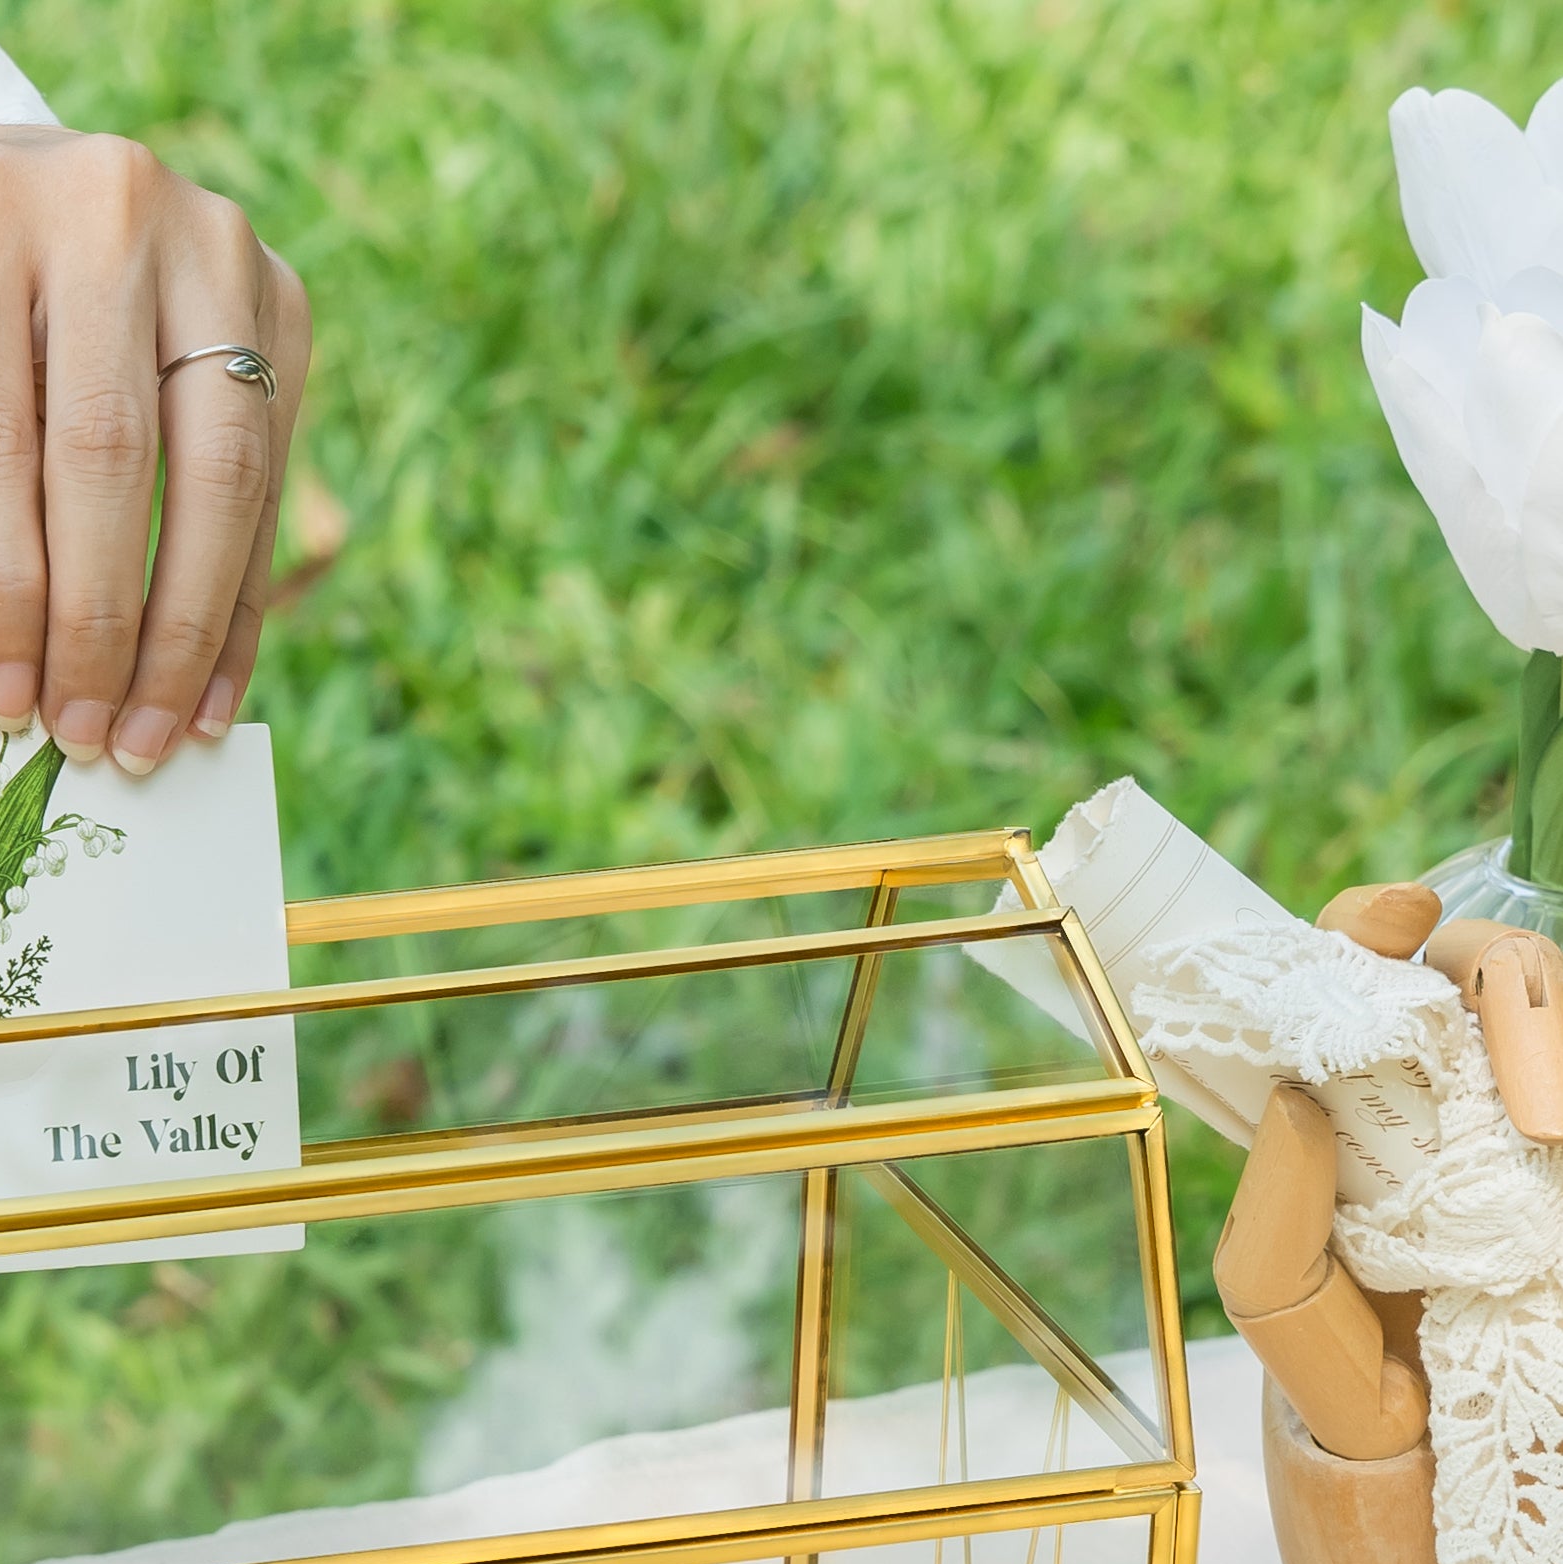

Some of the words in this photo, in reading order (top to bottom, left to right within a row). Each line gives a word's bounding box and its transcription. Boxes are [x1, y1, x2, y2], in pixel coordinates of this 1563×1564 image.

[126, 1052, 198, 1101] Lily
[216, 1045, 265, 1084] Of
[43, 1124, 122, 1162] The
[138, 1113, 265, 1161] Valley
